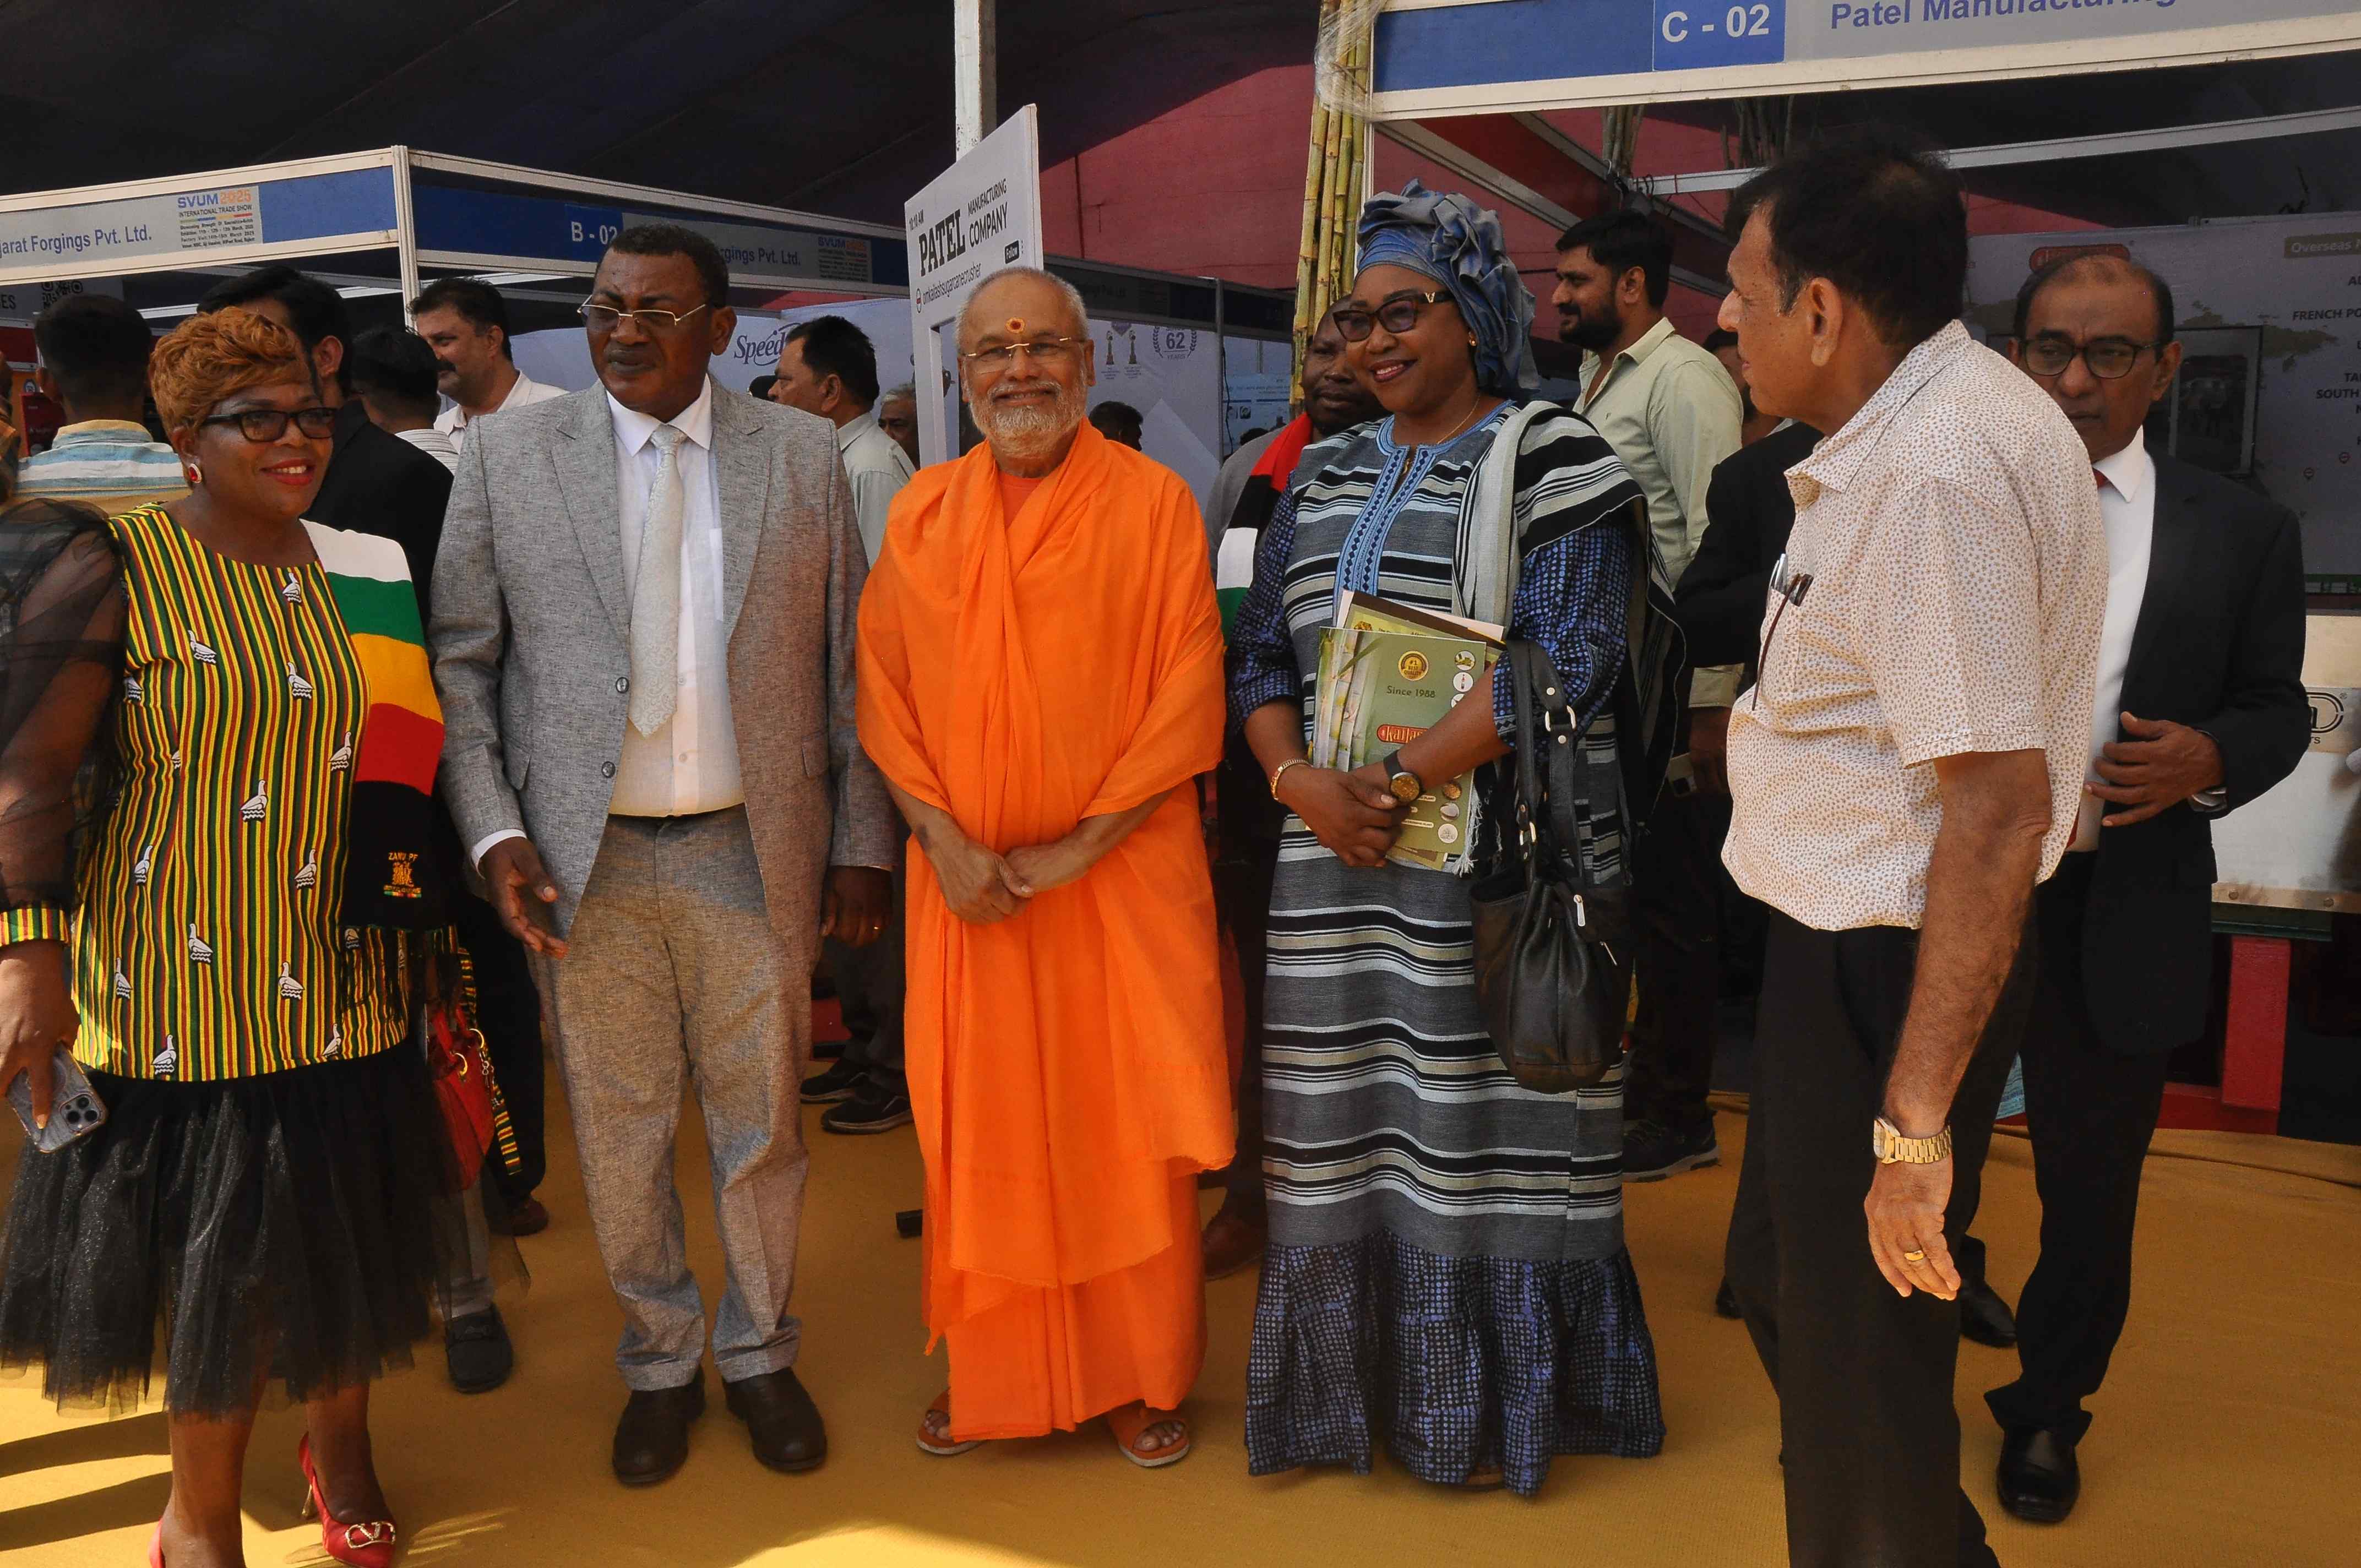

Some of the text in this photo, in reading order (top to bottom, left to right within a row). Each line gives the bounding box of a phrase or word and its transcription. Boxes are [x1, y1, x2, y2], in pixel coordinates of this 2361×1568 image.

[1662, 11, 1688, 42] C
[1726, 4, 1770, 38] 02
[1831, 2, 1911, 29] Patel
[178, 189, 252, 208] SVUM 2025
[967, 178, 1007, 216] MANUFACTURING
[179, 208, 217, 217] INTERNATIONAL
[572, 221, 583, 242] B
[599, 225, 617, 244] 02
[969, 202, 1008, 247] COMPANY
[31, 233, 90, 254] Forgings
[95, 229, 121, 246] Pvt.
[125, 224, 151, 243] Ltd.
[919, 209, 966, 277] PATEL
[2291, 242, 2352, 253] Overseas
[758, 248, 778, 263] Pvt.
[781, 251, 801, 265] Ltd.
[1, 294, 16, 309] ES
[2292, 309, 2342, 320] FRENCH
[1166, 332, 1185, 349] 62
[2344, 373, 2361, 383] TA
[2316, 389, 2359, 399] SOUTH
[1386, 685, 1436, 698] Since 1988
[409, 853, 418, 862] PF
